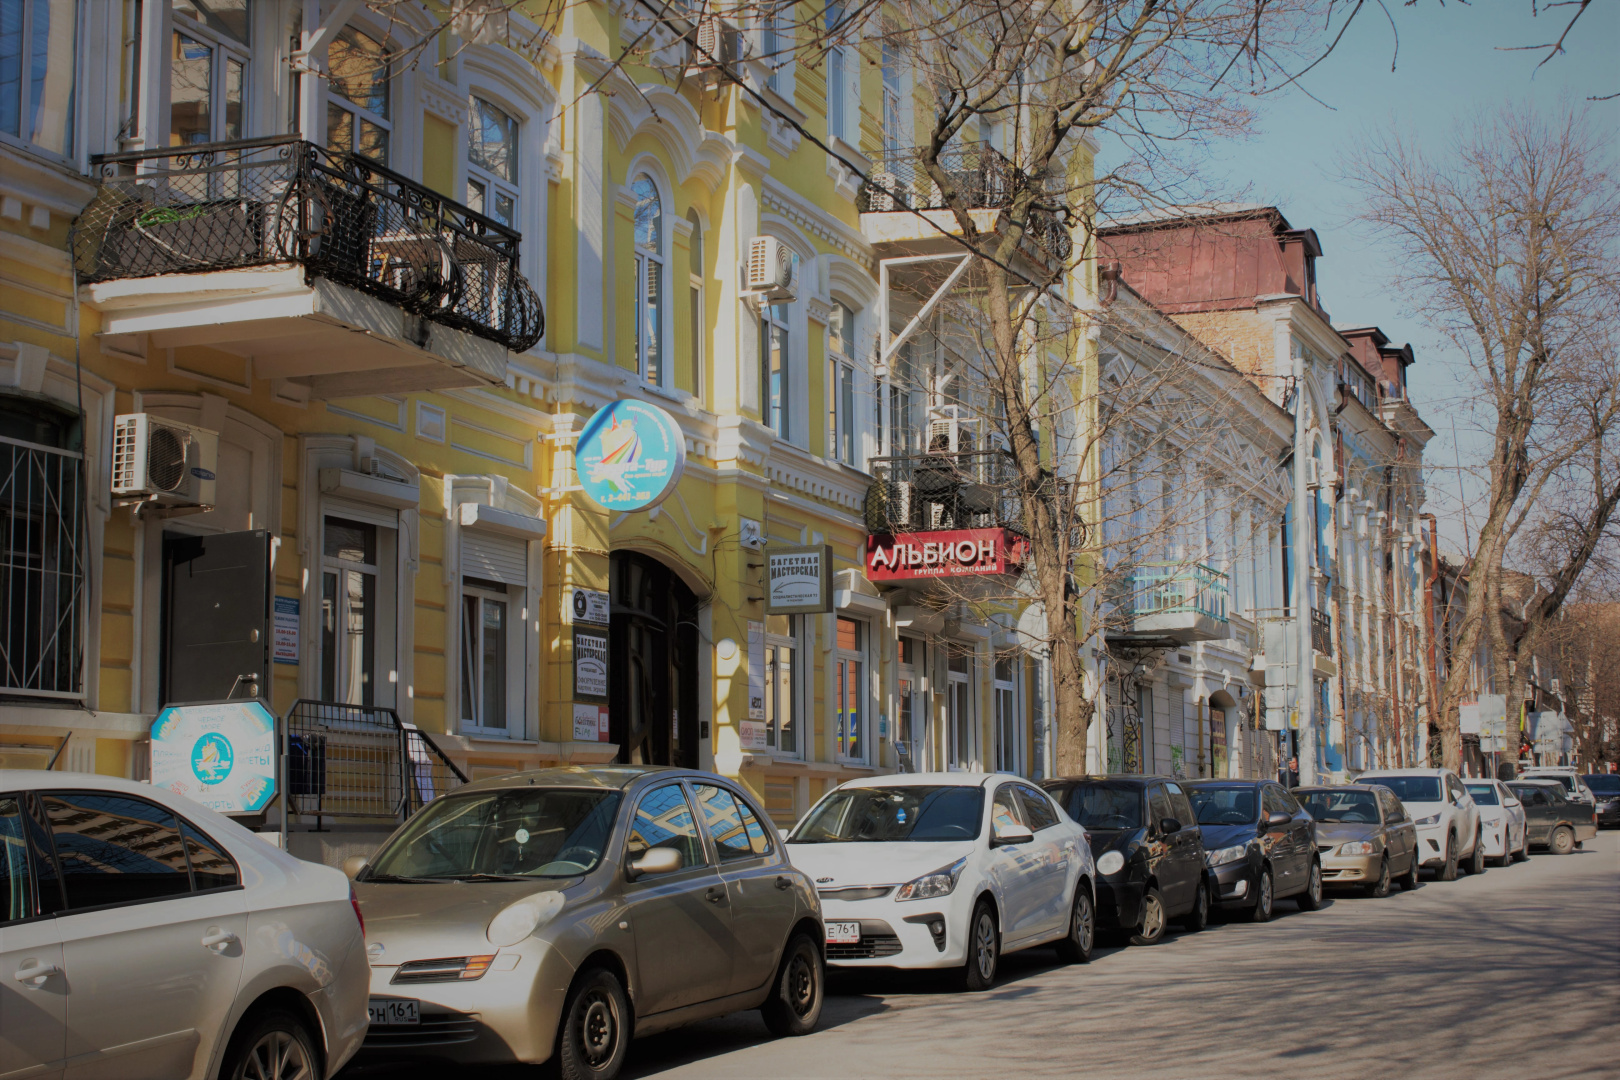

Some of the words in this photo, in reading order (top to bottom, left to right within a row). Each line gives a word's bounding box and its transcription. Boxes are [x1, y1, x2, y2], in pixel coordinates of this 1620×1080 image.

[870, 539, 995, 569] АЛЬБИОН
[771, 556, 818, 566] БАГЕТНАЯ
[771, 565, 818, 580] МАСТЕРСКАЯ
[914, 568, 944, 576] ГРУППА
[950, 564, 997, 574] КОМПАНИЙ
[577, 637, 606, 649] БАГЕТНАЯ
[577, 647, 606, 664] МАСТЕРСКАЯ
[837, 923, 856, 934] 761
[389, 1003, 414, 1017] 161
